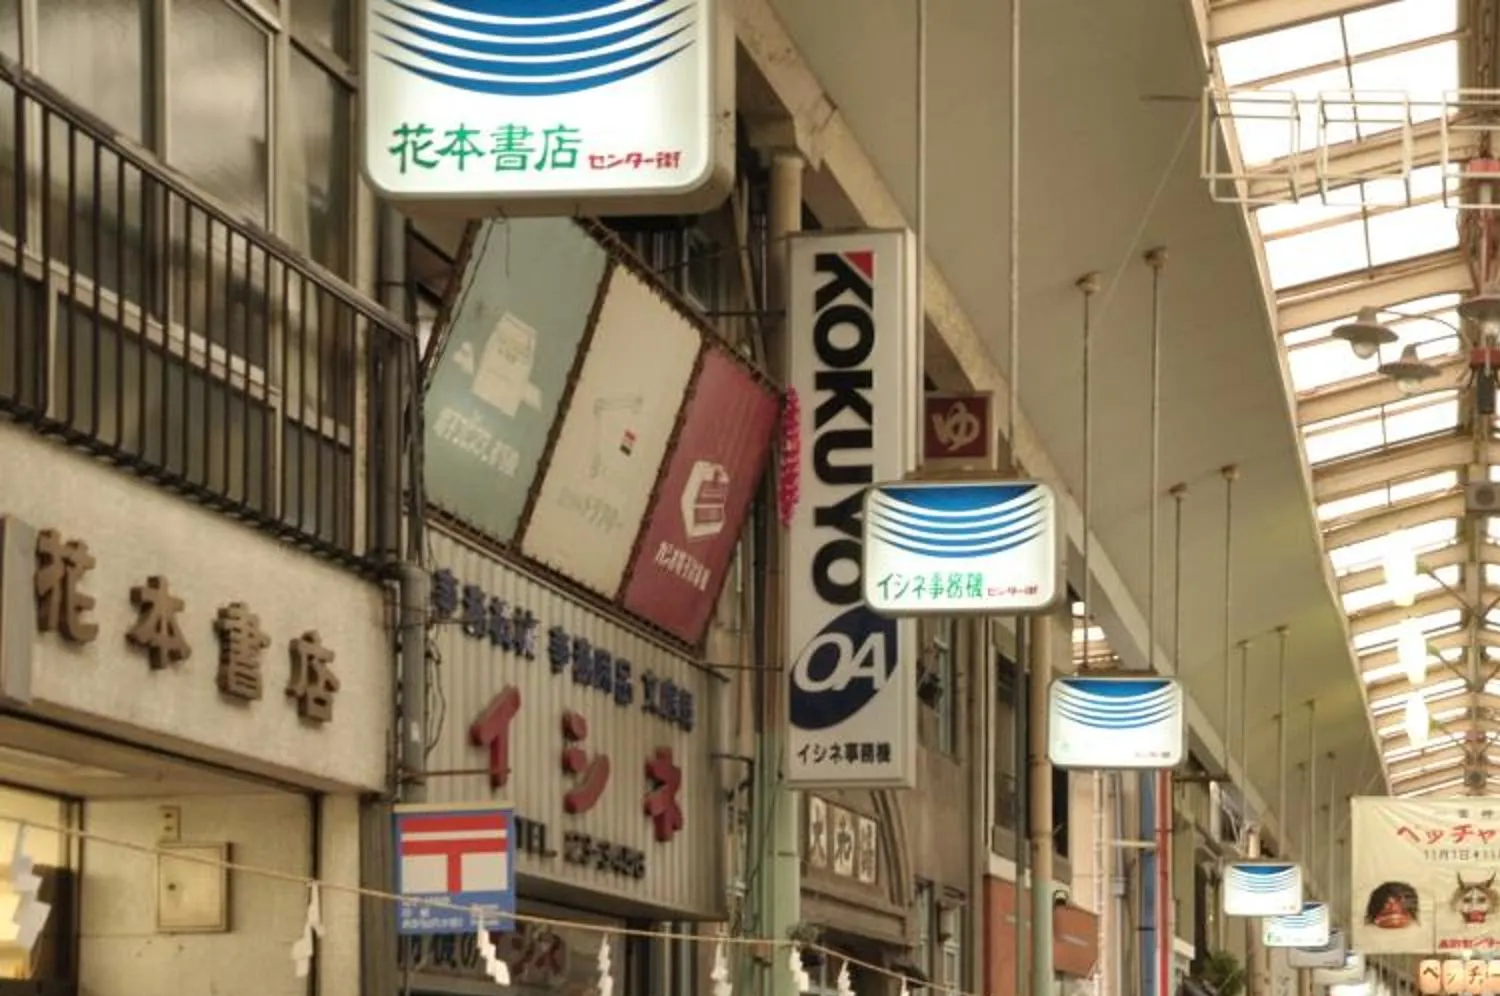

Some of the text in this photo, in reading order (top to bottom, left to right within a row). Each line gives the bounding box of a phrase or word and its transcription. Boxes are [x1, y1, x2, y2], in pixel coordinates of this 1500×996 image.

[388, 123, 682, 172] 花本書店 センター街
[813, 251, 875, 605] KOKUYO
[930, 401, 981, 451] ゆ
[33, 526, 341, 724] 花本書店
[794, 631, 889, 693] OA
[467, 683, 684, 843] イシネ
[797, 742, 893, 764] イシネ事務機
